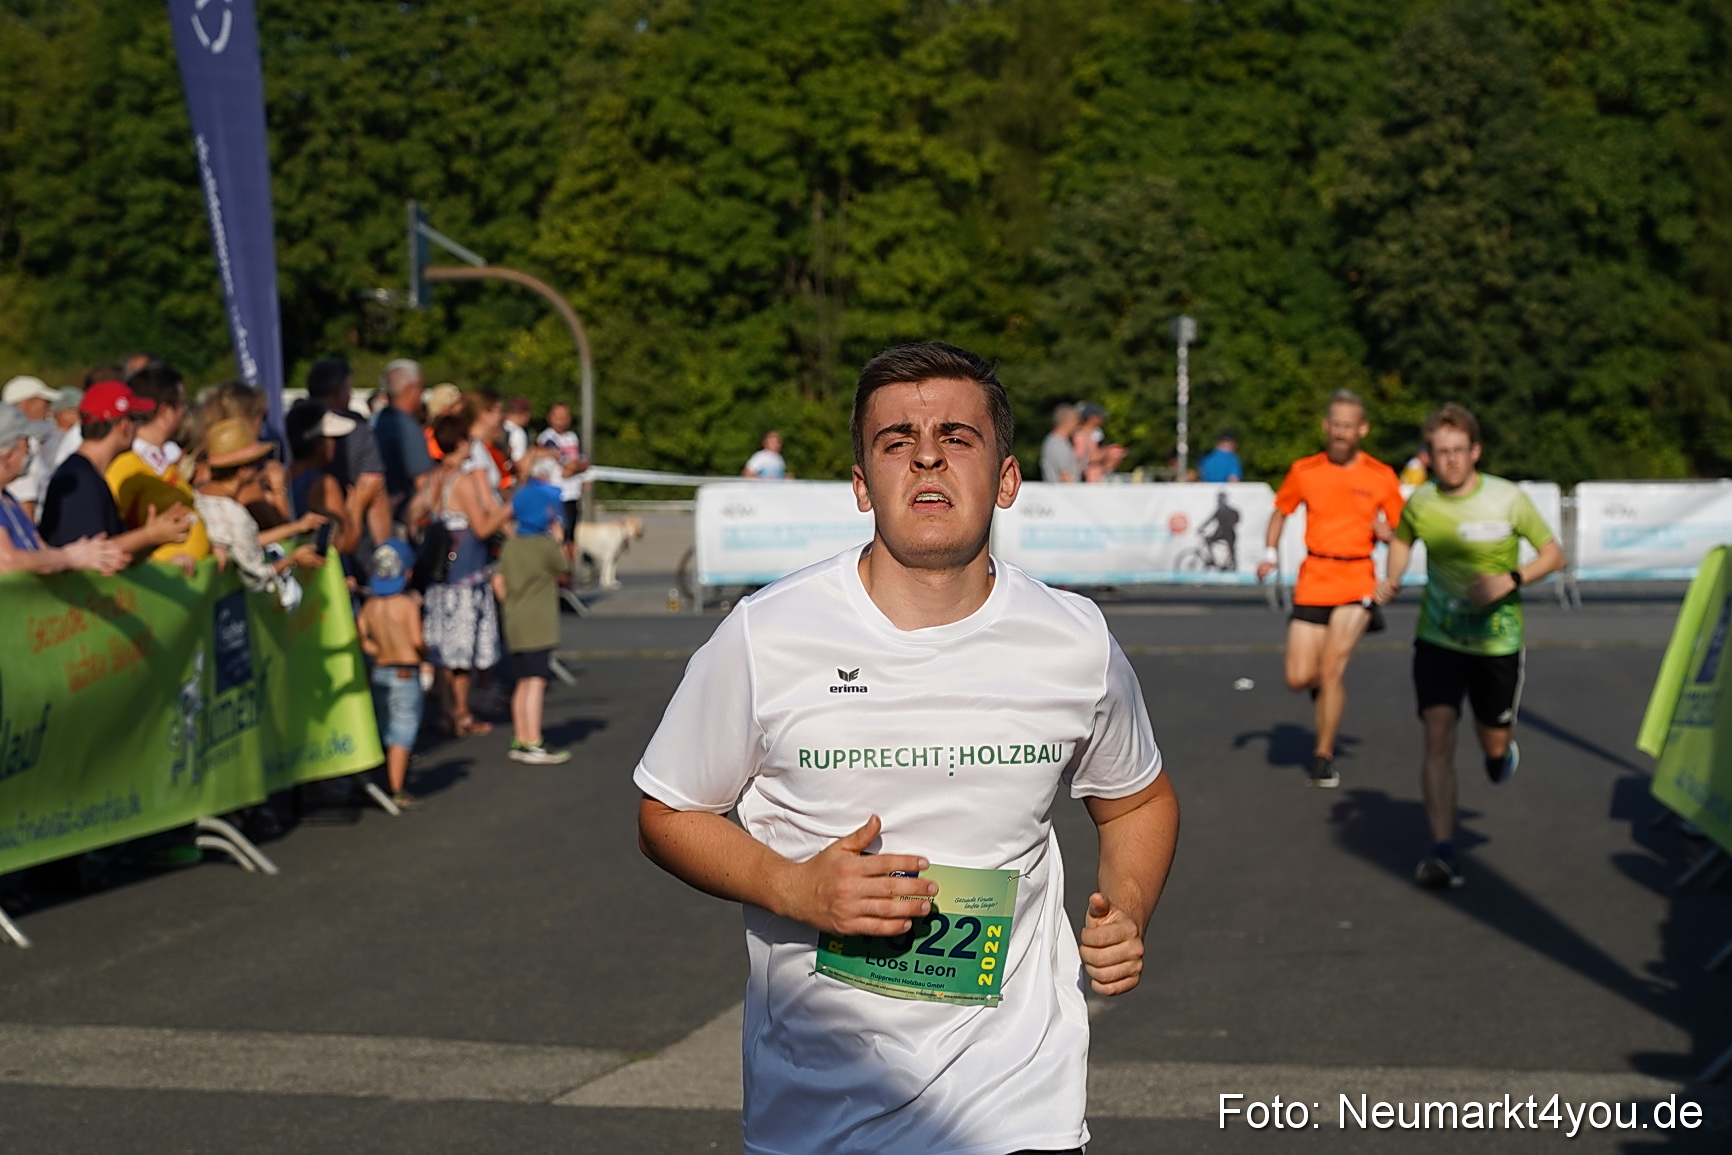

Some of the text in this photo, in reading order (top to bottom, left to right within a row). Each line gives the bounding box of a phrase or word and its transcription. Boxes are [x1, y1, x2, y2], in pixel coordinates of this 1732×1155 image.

[829, 684, 868, 693] erima
[799, 743, 1062, 769] RUPPRECHT HOLZBAU
[865, 951, 957, 978] Loos Leon
[978, 925, 1002, 986] 2022
[869, 972, 945, 989] Rupprecht Holzbau GmbH
